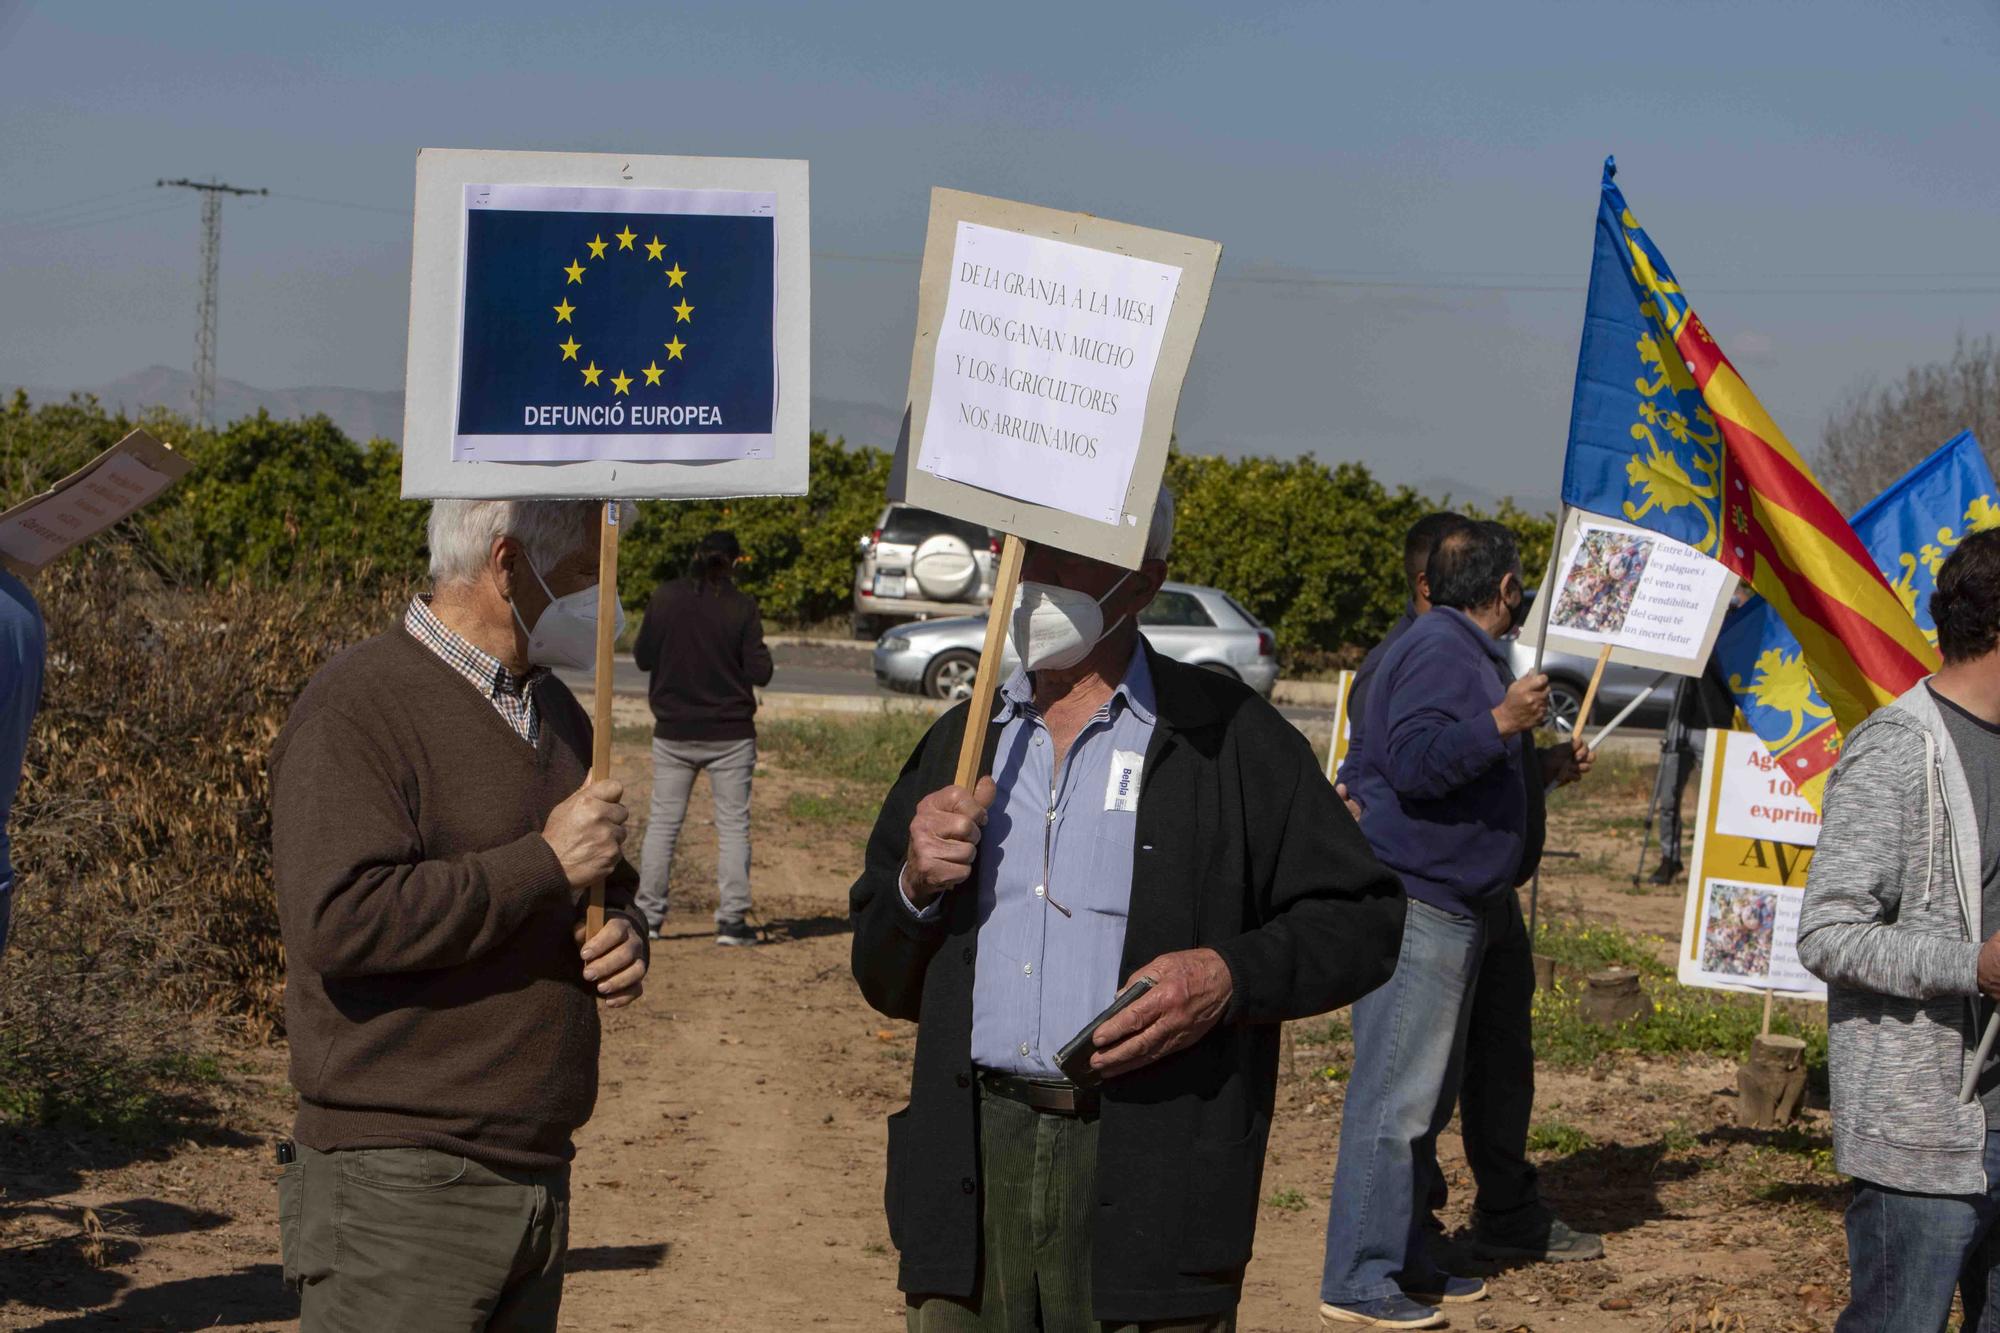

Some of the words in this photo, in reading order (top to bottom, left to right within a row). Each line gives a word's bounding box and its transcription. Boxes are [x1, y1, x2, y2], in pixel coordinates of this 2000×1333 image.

[960, 262, 982, 286] DE
[983, 267, 1000, 290] LA
[1003, 272, 1066, 306] GRANJA
[1071, 288, 1083, 310] A
[1089, 291, 1109, 316] LA
[1112, 297, 1155, 326] MESA
[959, 308, 1001, 338] UNOS
[1004, 319, 1067, 352] GANAN
[1069, 336, 1135, 370] MUCHO
[955, 354, 967, 376] Y
[968, 358, 998, 384] LOS
[999, 367, 1120, 416] AGRICULTORES
[524, 401, 625, 426] DEFUNCIÓ
[631, 405, 723, 426] EUROPEA
[958, 402, 991, 430] NOS
[991, 413, 1099, 459] ARRUINAMOS
[1656, 542, 1683, 555] Entre
[1650, 559, 1664, 570] les
[1665, 562, 1700, 576] plagues
[1643, 576, 1653, 585] el
[1655, 579, 1675, 589] veto
[1637, 591, 1646, 600] la
[1648, 595, 1699, 610] rendibilitat
[1630, 608, 1646, 619] del
[1647, 613, 1672, 625] caqui
[1624, 626, 1637, 636] un
[1638, 628, 1666, 641] incert
[1667, 631, 1691, 644] futur
